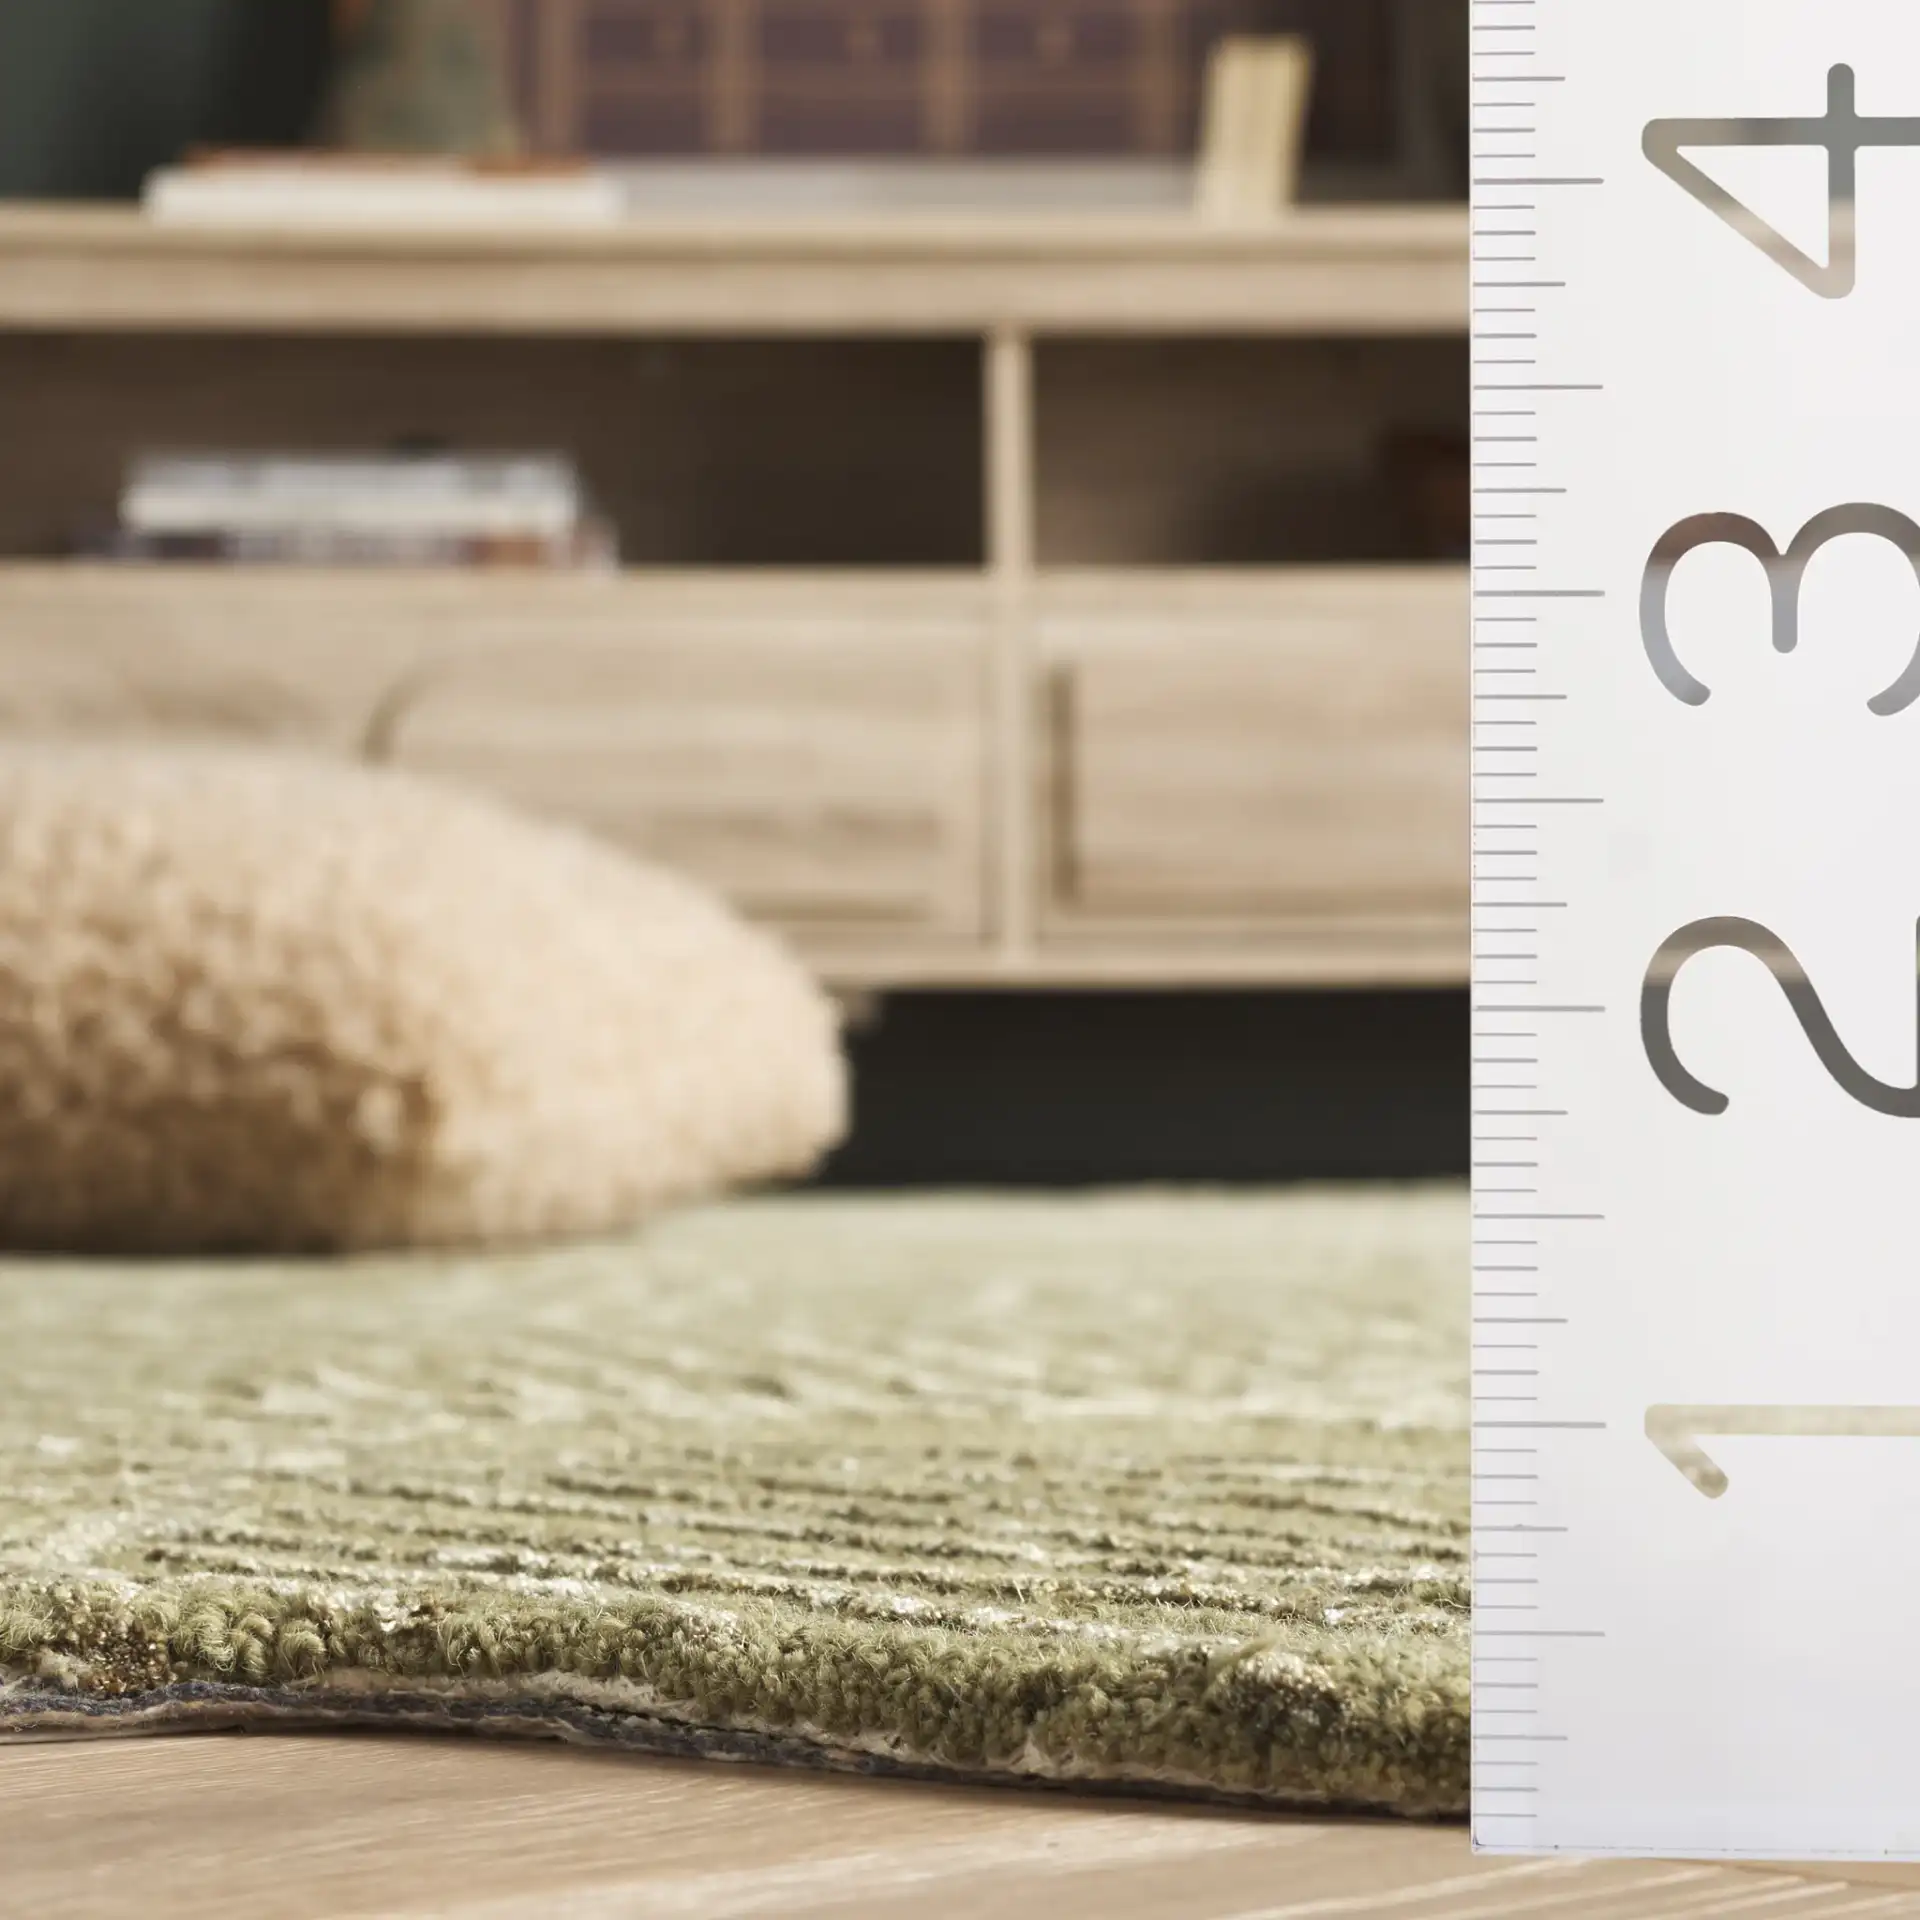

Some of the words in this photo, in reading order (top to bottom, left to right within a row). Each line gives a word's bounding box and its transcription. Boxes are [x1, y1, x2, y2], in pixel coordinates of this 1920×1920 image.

[1641, 63, 1920, 298] 4
[1639, 502, 1920, 716] 3
[1640, 916, 1920, 1118] 2
[1644, 1404, 1920, 1499] 1
